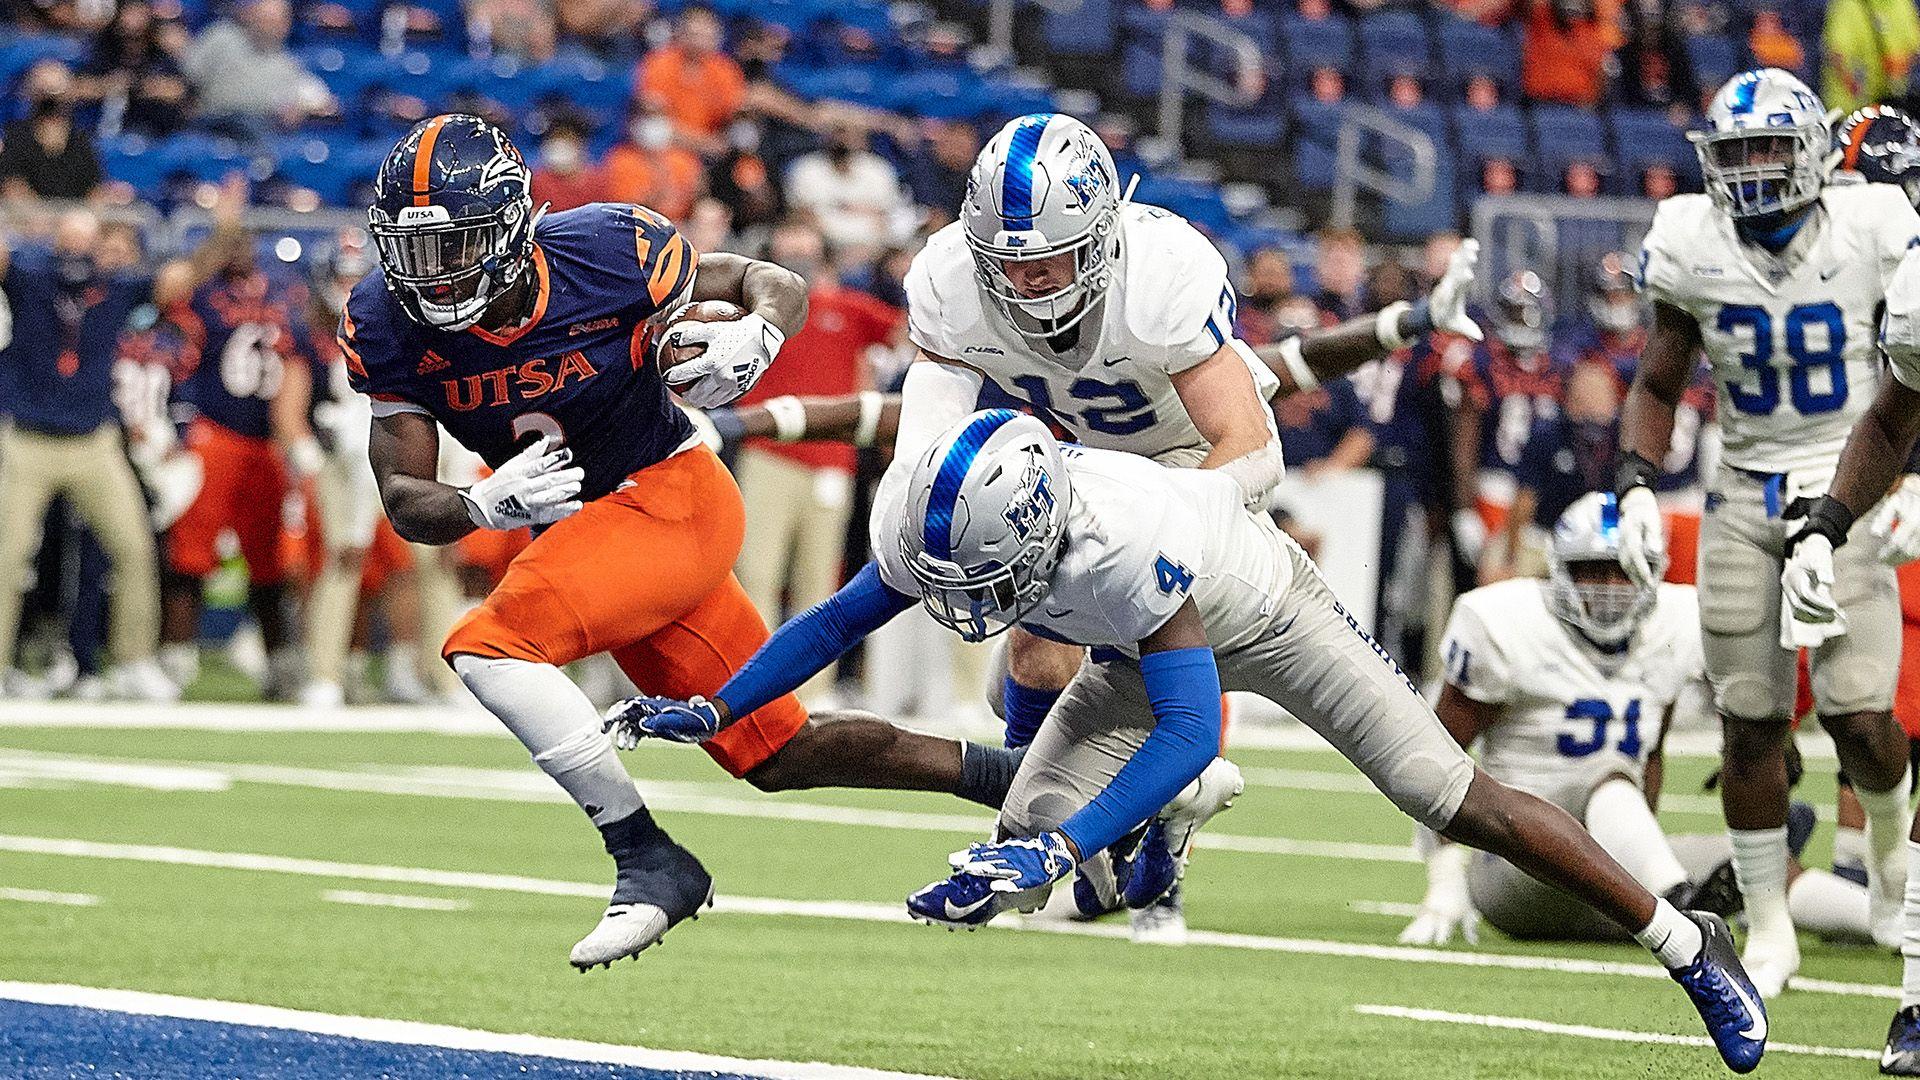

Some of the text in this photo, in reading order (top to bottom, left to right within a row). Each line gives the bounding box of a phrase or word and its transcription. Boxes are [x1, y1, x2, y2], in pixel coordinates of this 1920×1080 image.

[407, 211, 434, 219] UTSA
[441, 350, 599, 411] UTSA
[1717, 301, 1848, 417] 38
[1010, 373, 1159, 437] 12
[1152, 551, 1196, 598] 4
